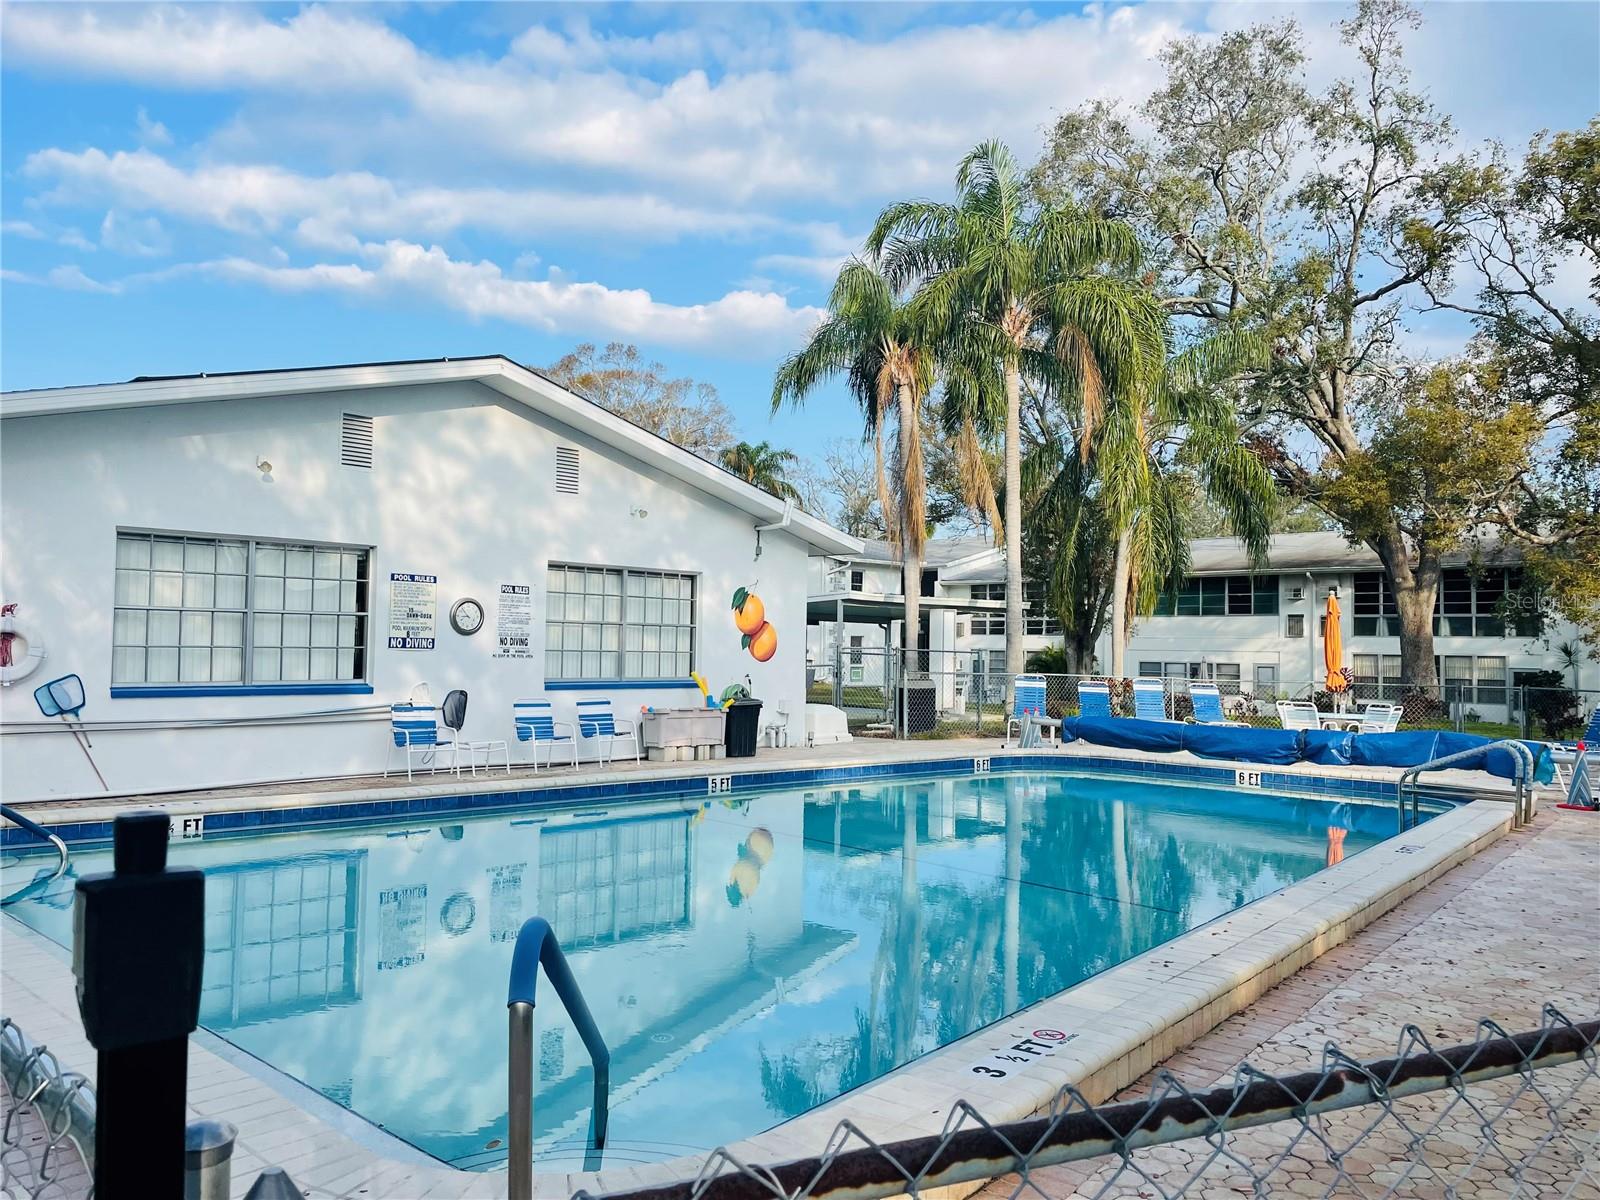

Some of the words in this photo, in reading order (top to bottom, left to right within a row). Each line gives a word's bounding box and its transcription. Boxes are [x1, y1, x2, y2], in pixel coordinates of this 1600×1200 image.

[414, 575, 435, 583] RULES
[501, 585, 513, 593] POOL
[514, 586, 529, 594] RULES
[390, 637, 403, 648] NO
[406, 638, 433, 649] DIVING
[499, 637, 508, 646] NO
[509, 637, 529, 647] DIVING
[976, 759, 981, 772] 6
[982, 759, 990, 771] FT
[711, 778, 717, 793] 5
[720, 777, 730, 792] FT
[1239, 772, 1245, 784] 6
[1248, 773, 1260, 786] FT
[183, 818, 202, 836] FT
[972, 1066, 1007, 1078] 3
[1010, 1038, 1054, 1056] FT
